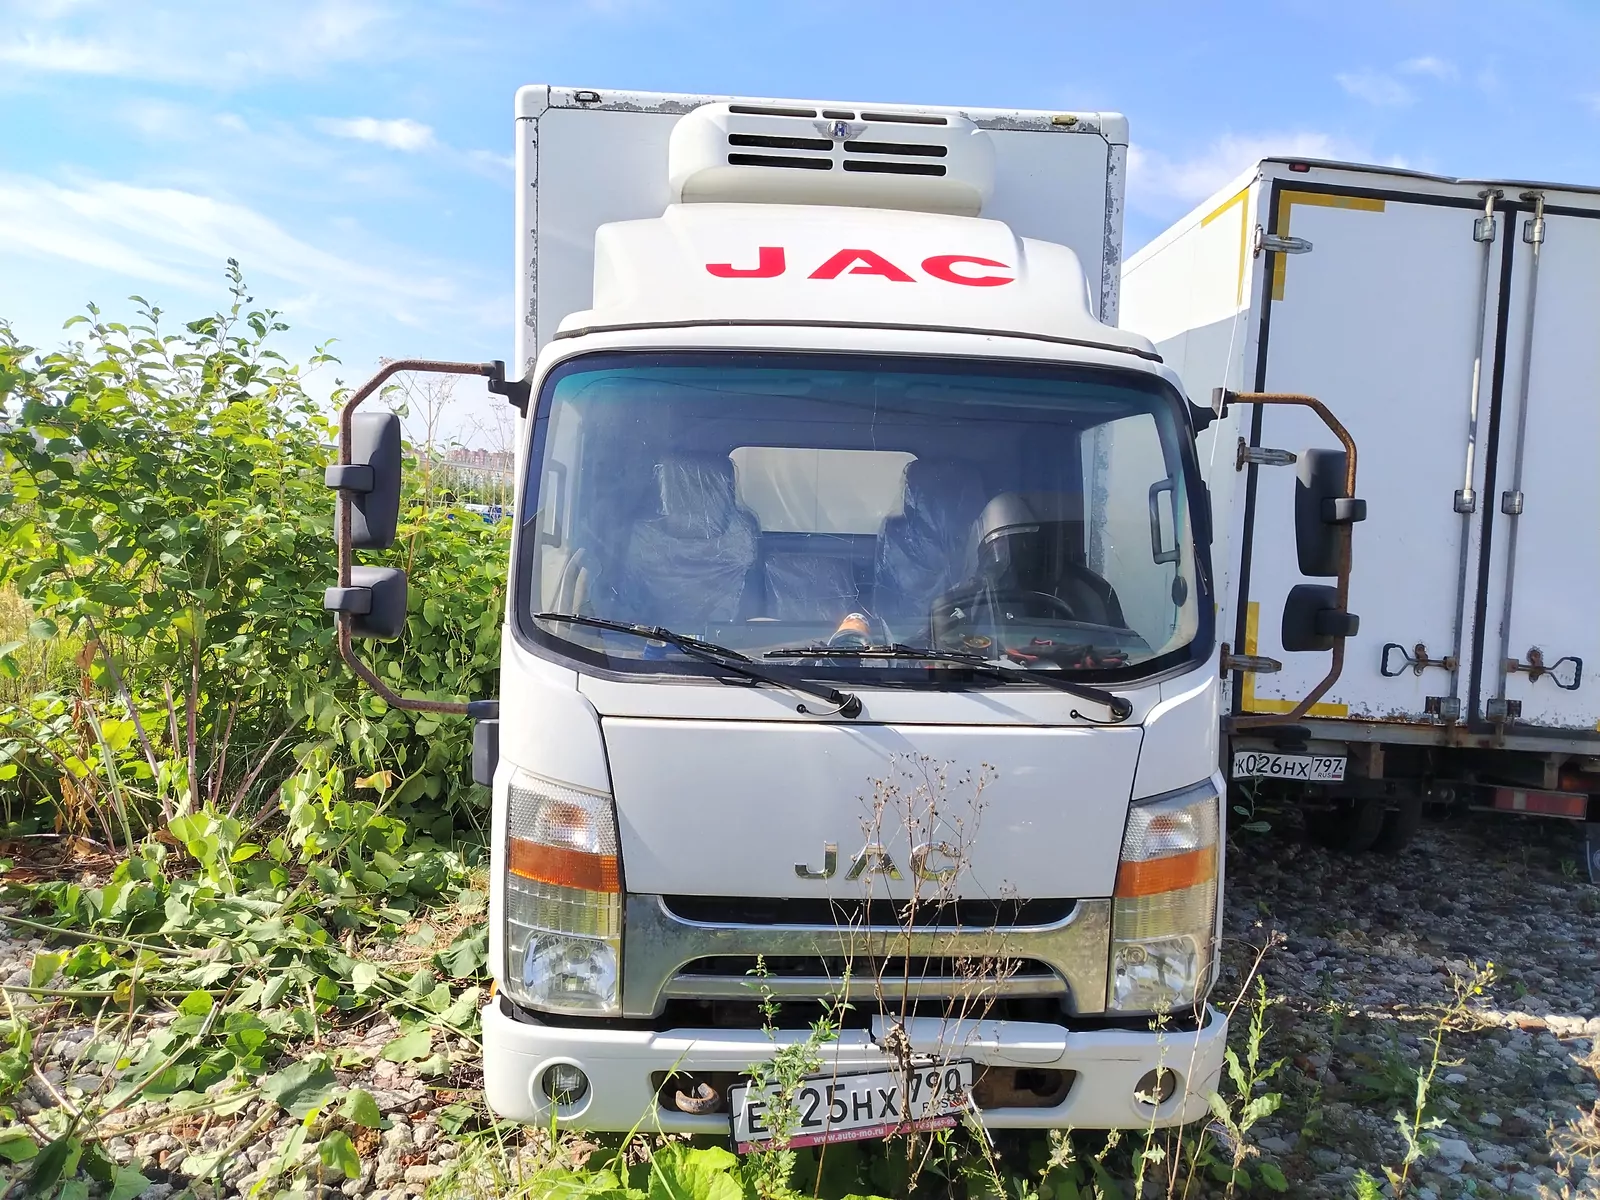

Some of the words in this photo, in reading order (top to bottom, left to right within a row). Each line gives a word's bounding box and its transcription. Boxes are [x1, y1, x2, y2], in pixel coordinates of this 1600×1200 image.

[706, 246, 1015, 287] JAC
[1314, 758, 1342, 773] 797
[794, 840, 962, 881] JAC
[747, 1083, 899, 1134] E25HX
[909, 1068, 962, 1103] 790
[813, 1127, 884, 1143] www.auto-mo.ru
